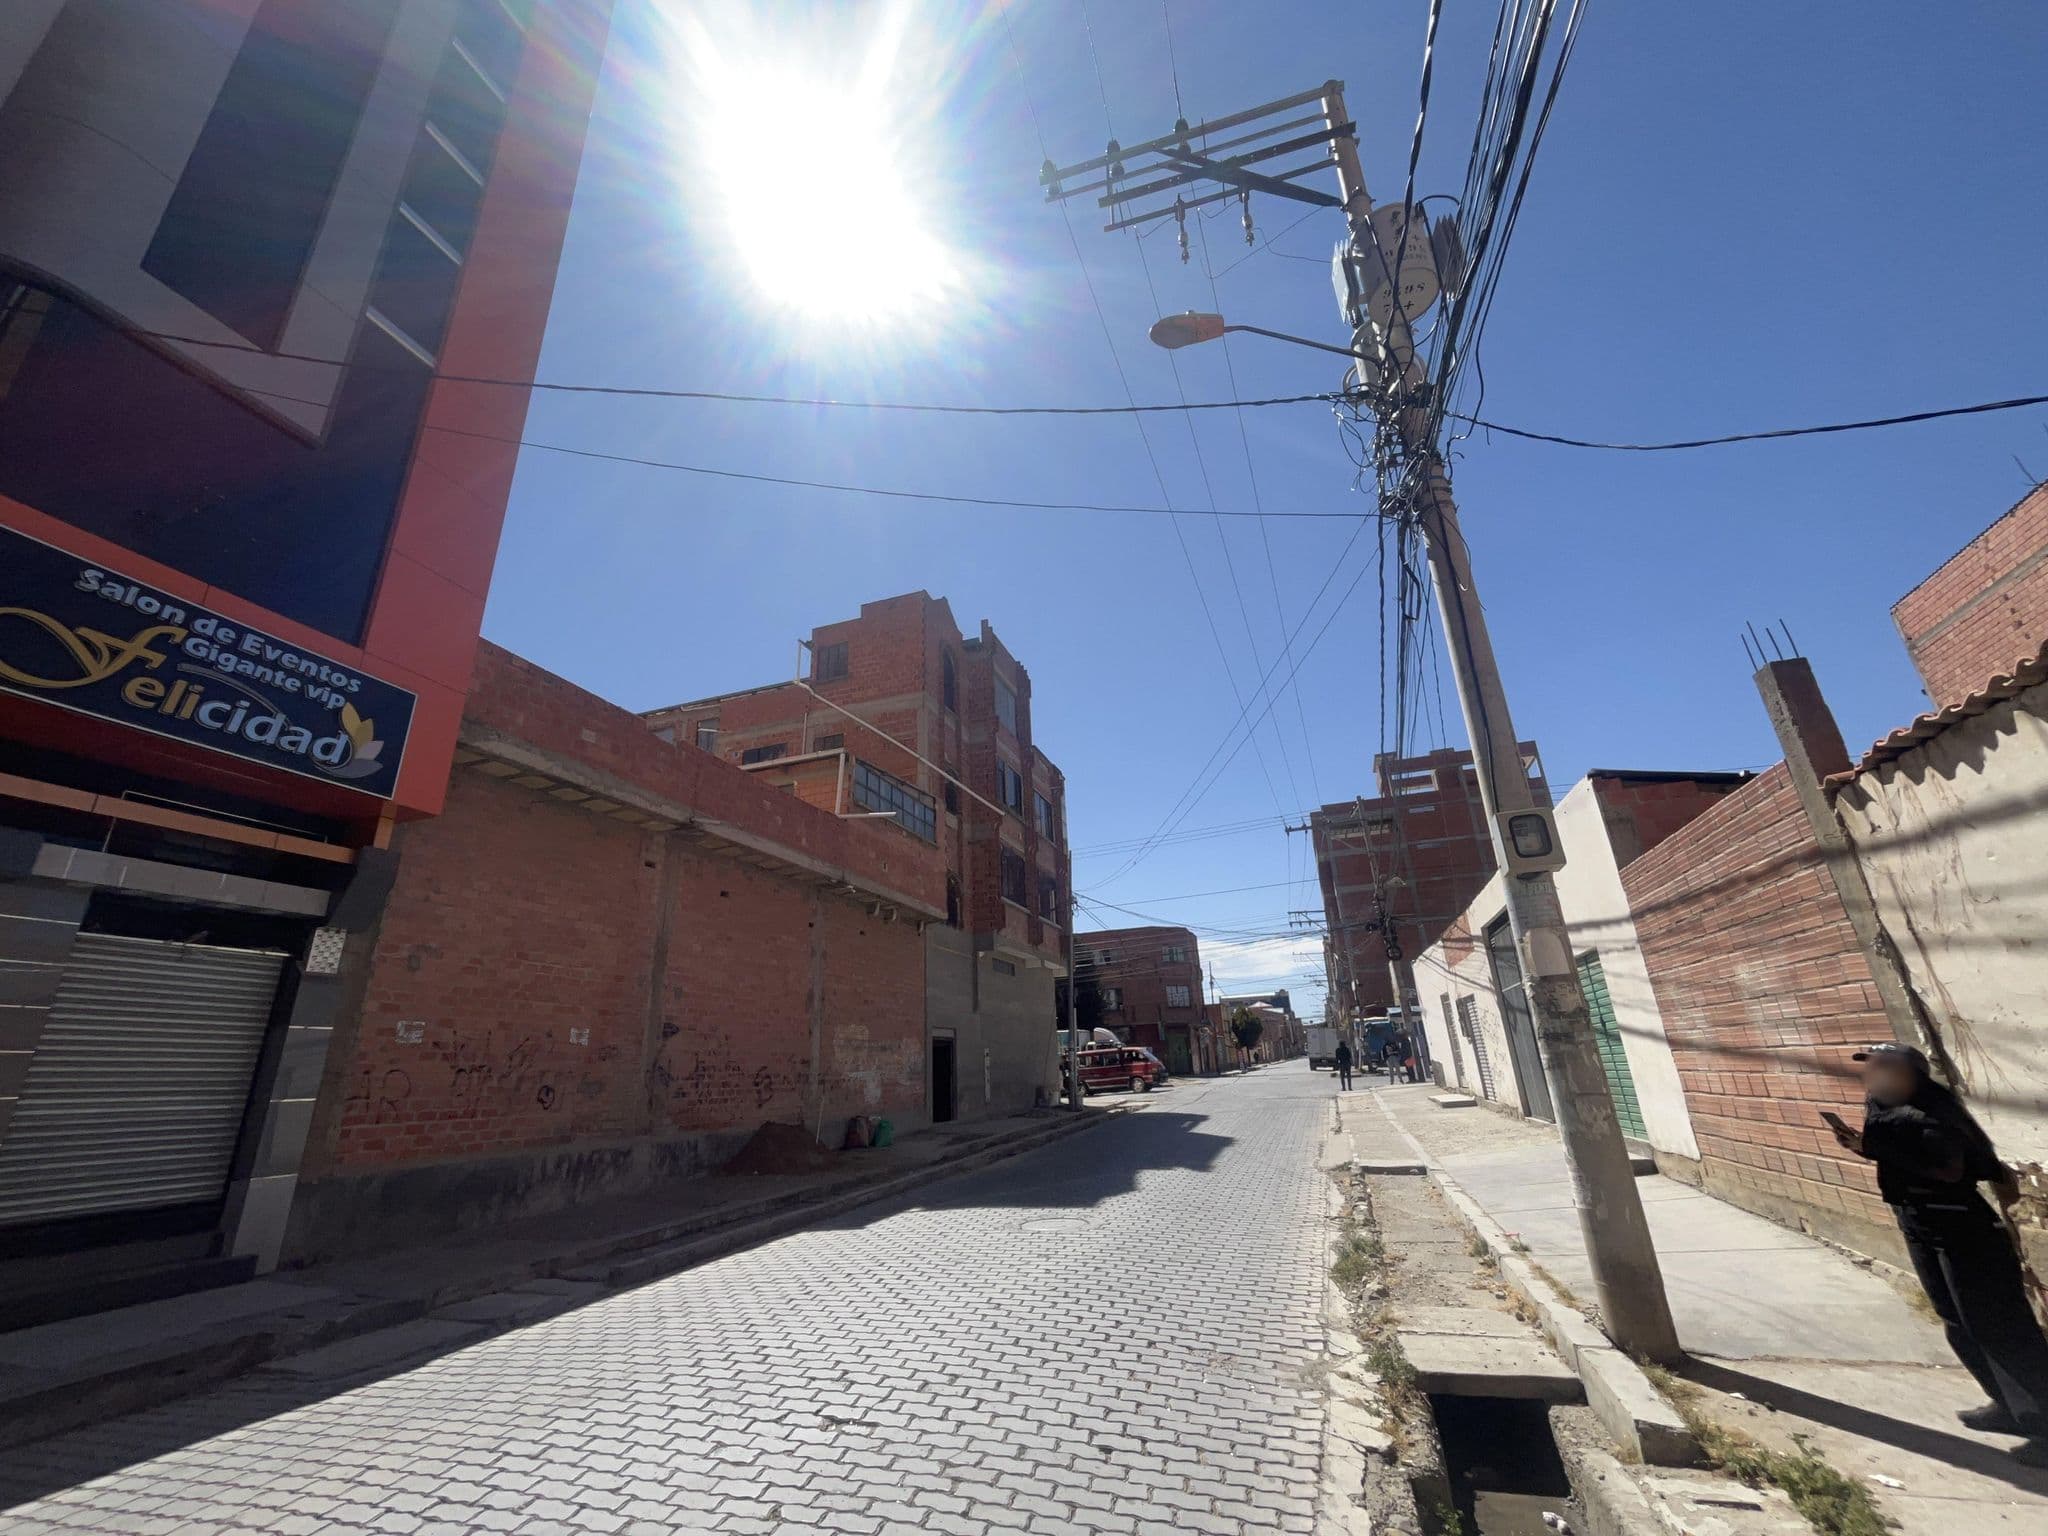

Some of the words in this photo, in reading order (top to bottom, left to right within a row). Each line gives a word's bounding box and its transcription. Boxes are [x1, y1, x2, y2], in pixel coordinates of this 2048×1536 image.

[75, 569, 186, 625] Salon
[191, 618, 236, 644] de
[239, 633, 361, 692] Eventos
[183, 637, 301, 692] Gigante
[305, 684, 346, 710] vip
